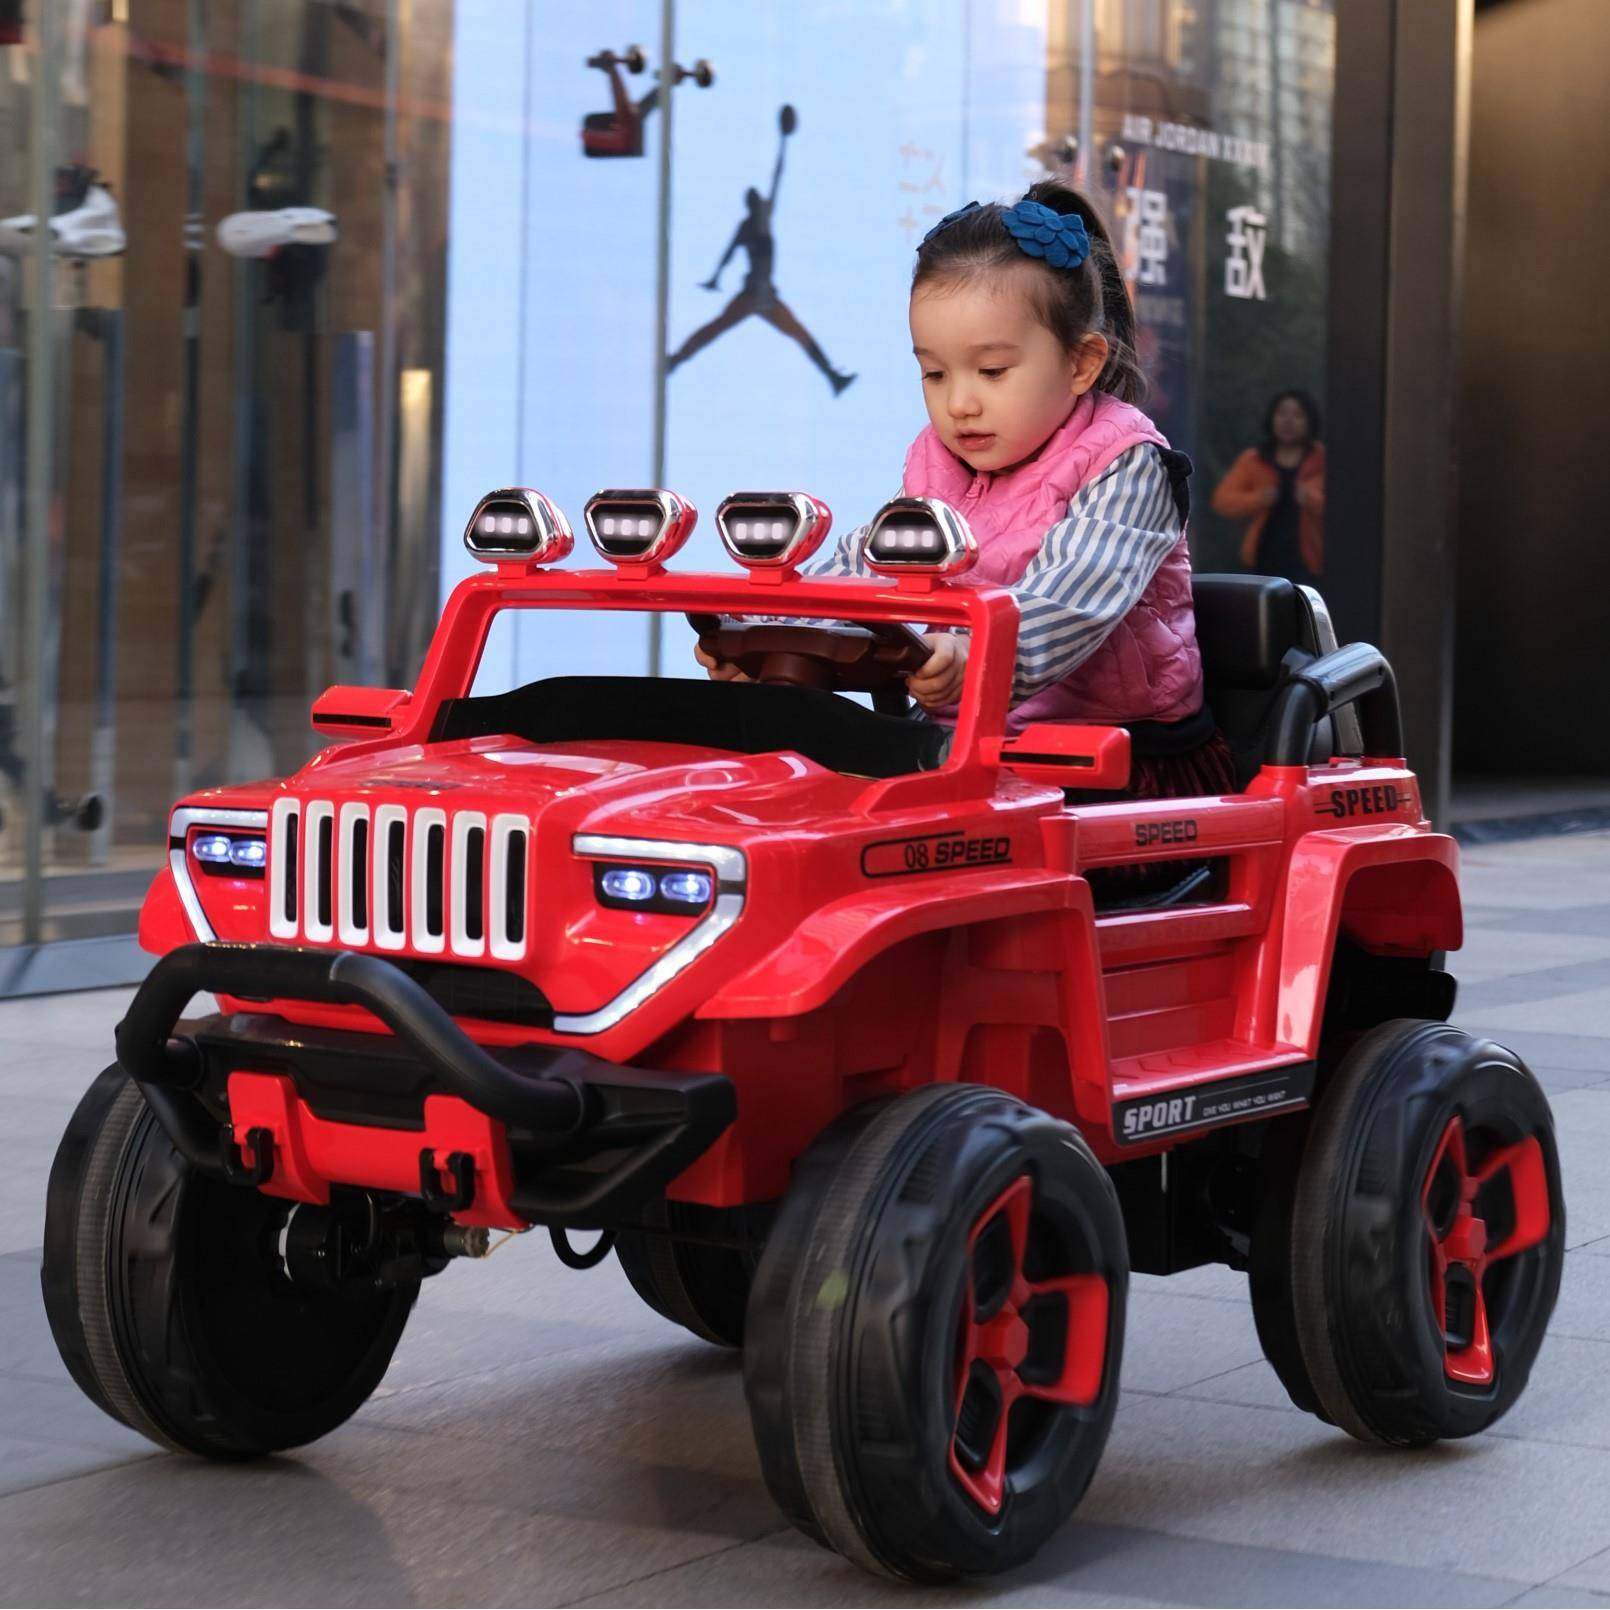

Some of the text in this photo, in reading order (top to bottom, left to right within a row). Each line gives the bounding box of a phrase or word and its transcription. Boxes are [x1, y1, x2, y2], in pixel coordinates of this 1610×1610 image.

[1121, 113, 1152, 144] AIR
[1155, 121, 1218, 160] JORDAN
[1331, 784, 1398, 818] SPEED
[1135, 819, 1198, 847] SPEED
[904, 837, 1011, 869] 08 SPEED
[1123, 1095, 1197, 1134] SPORT
